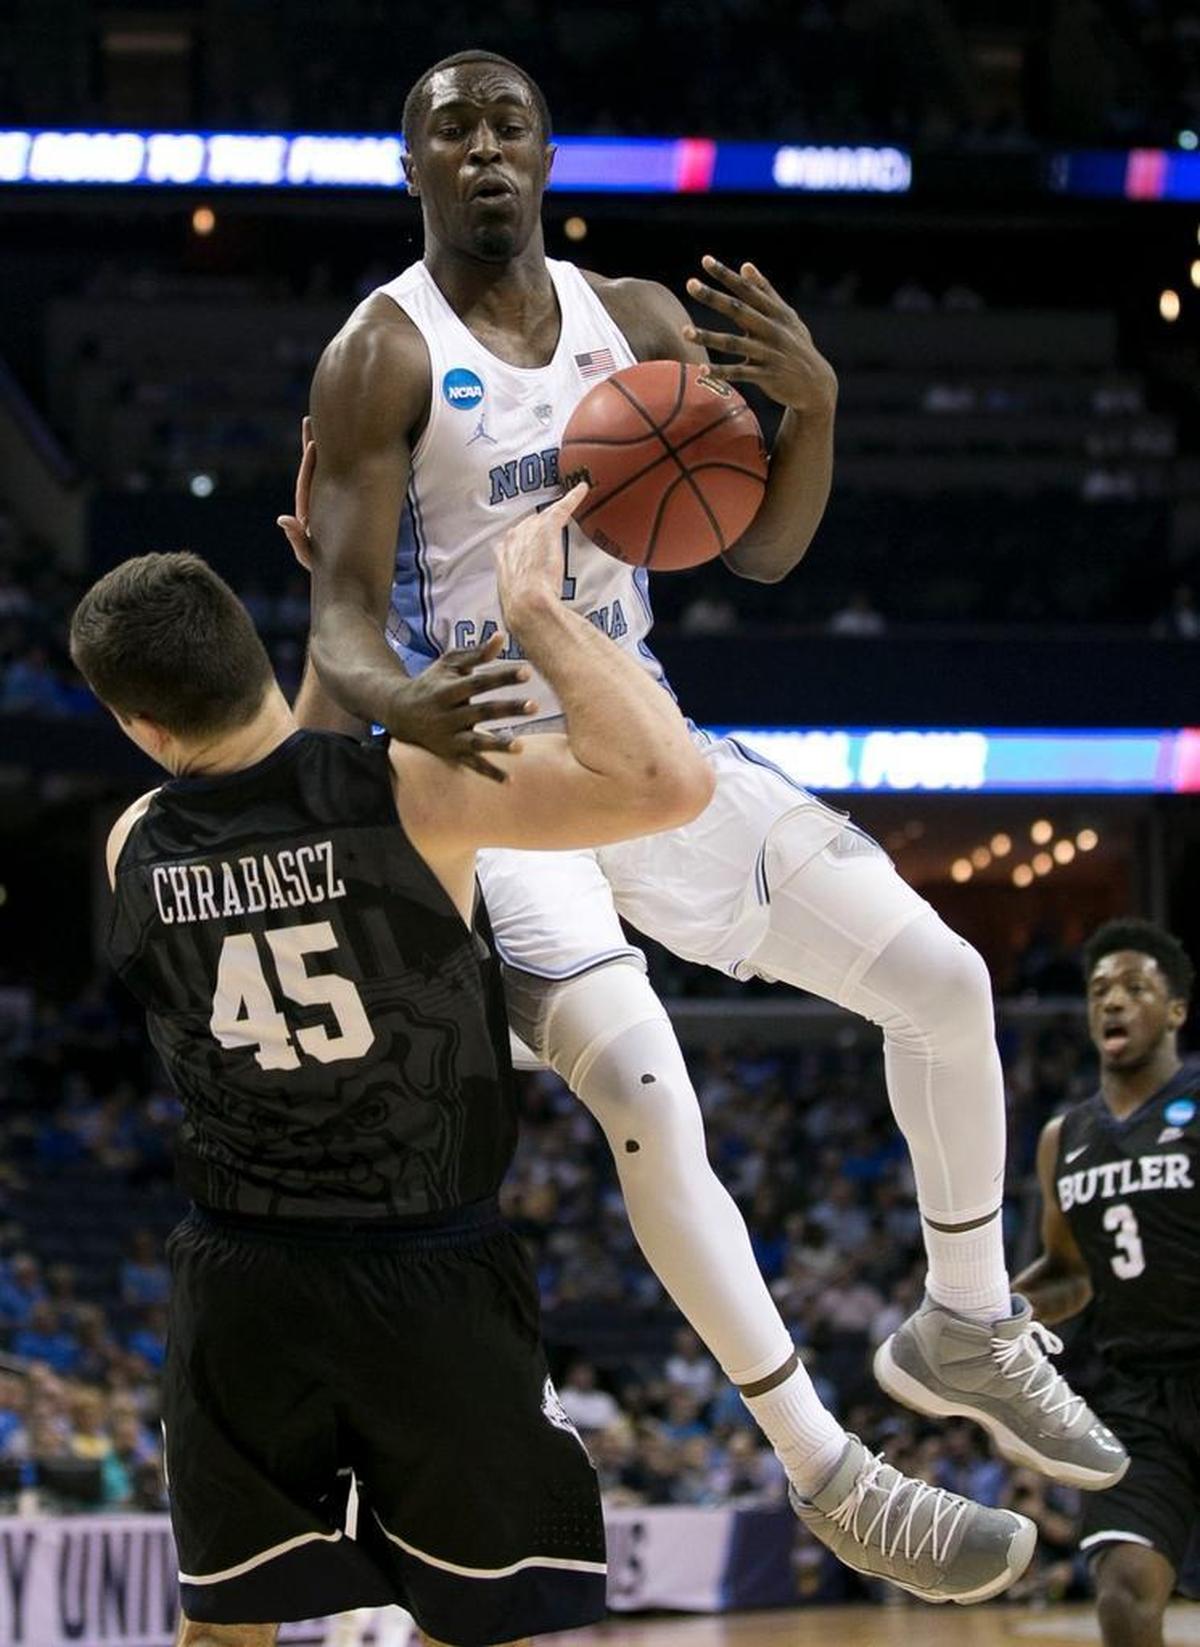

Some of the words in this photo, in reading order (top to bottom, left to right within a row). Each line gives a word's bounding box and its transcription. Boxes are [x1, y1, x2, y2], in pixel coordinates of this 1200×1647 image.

[448, 385, 484, 400] NCAA
[488, 447, 561, 506] NOR
[152, 840, 347, 924] CHRABASCZ
[210, 920, 375, 1071] 45
[1057, 1153, 1195, 1212] BUTLER
[1103, 1203, 1145, 1280] 3
